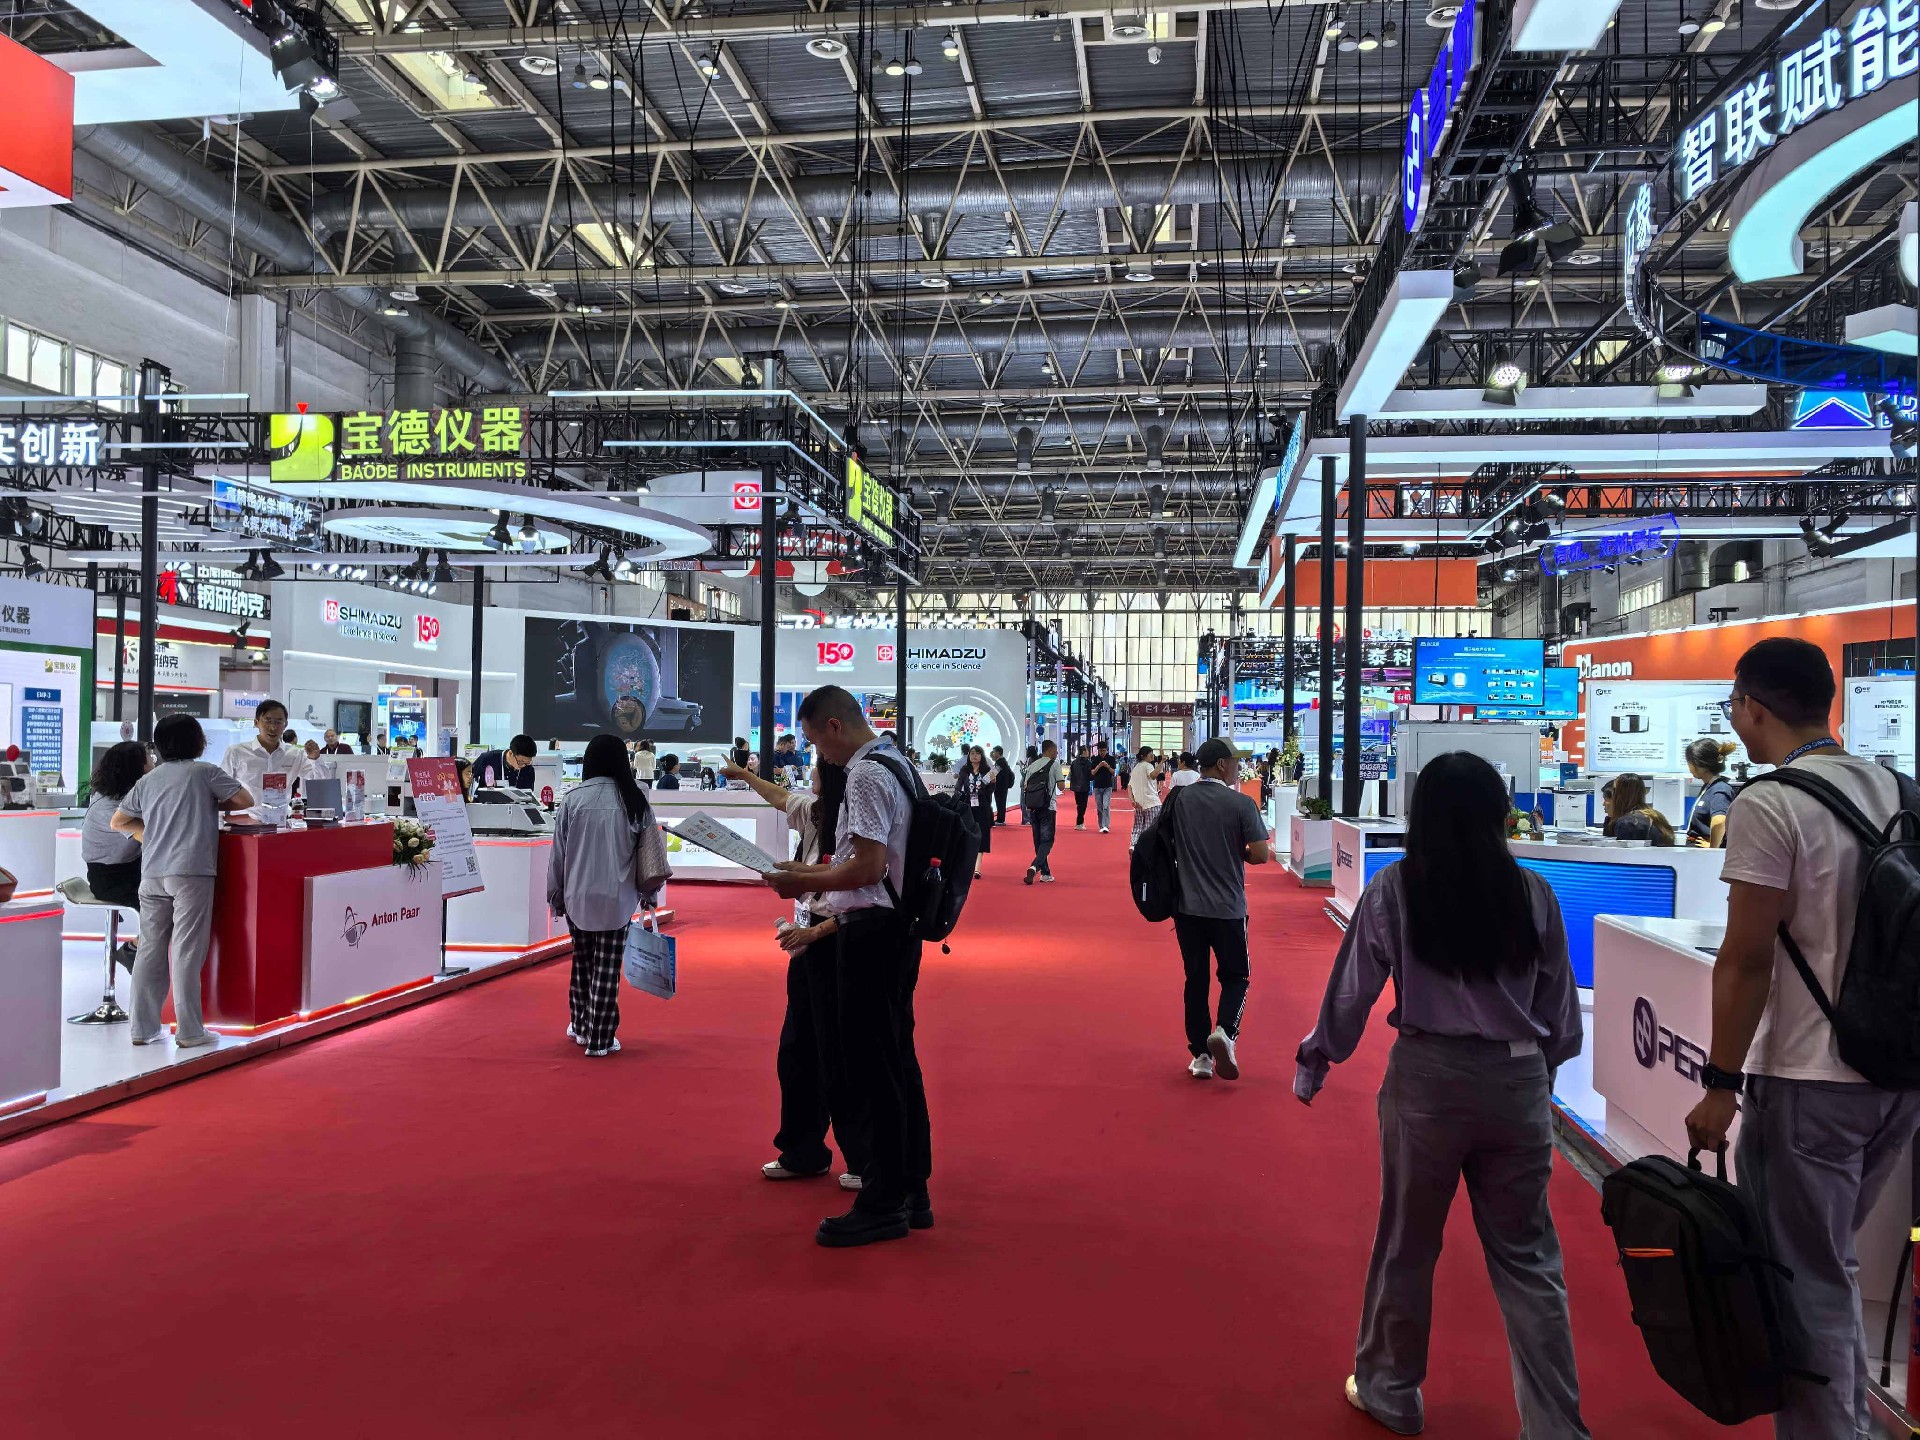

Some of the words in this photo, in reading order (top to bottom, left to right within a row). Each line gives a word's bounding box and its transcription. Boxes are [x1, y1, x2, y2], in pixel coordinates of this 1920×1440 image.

[1681, 0, 1918, 201] 智联赋能
[341, 407, 523, 456] 宝德仪器
[341, 463, 398, 480] BAODE
[406, 462, 526, 478] INSTRUMENTS
[197, 583, 265, 619] 钢研纳克
[1, 605, 30, 624] 仪器
[340, 606, 402, 629] SHIMADZU
[416, 614, 440, 643] 150
[817, 642, 854, 664] 150
[896, 648, 986, 660] HIMADZU
[905, 662, 940, 670] xcellence
[942, 662, 950, 670] in
[952, 662, 981, 670] Science
[371, 912, 398, 927] Anton
[400, 906, 420, 921] Paar
